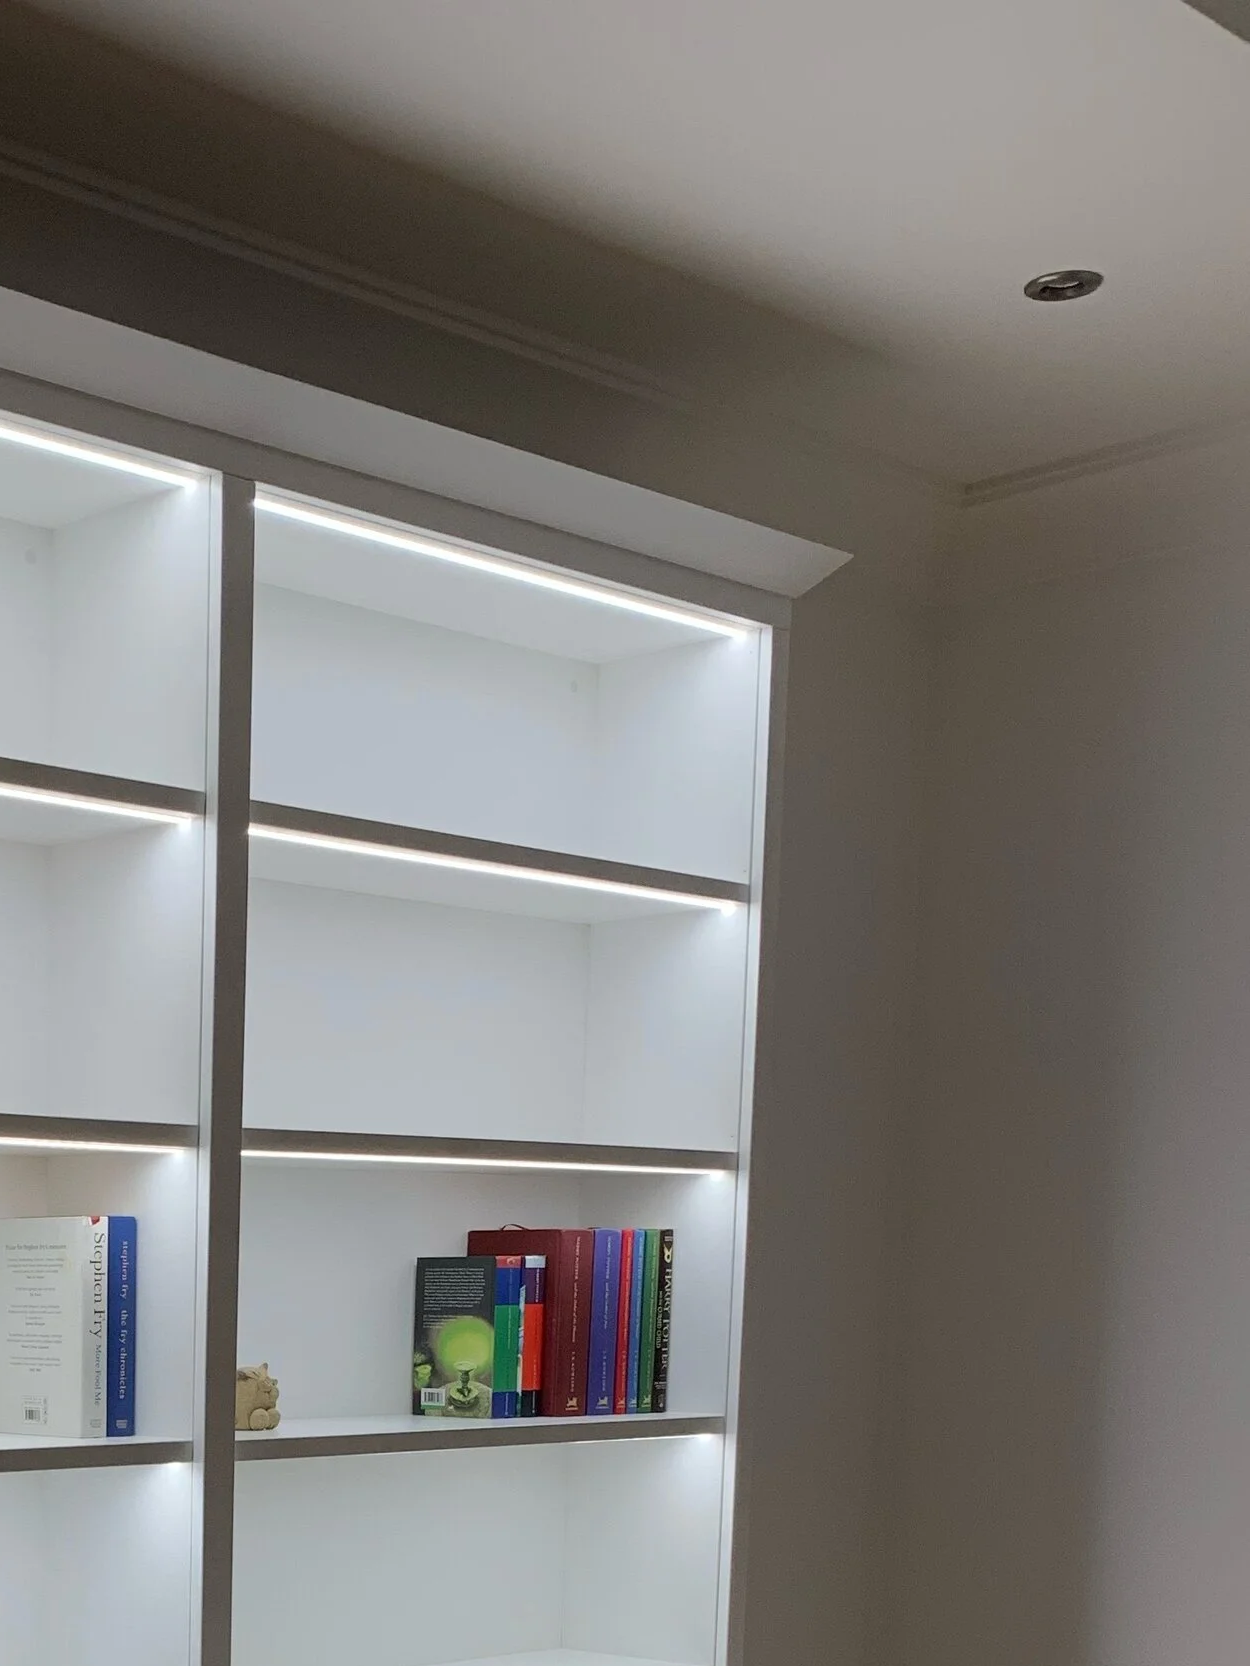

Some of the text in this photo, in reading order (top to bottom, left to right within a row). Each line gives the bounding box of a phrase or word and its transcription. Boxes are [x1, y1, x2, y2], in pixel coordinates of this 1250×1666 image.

[89, 1232, 106, 1341] Stephen Fry
[120, 1241, 128, 1300] stephen fry
[663, 1268, 673, 1313] HARRY
[119, 1329, 127, 1345] fry
[94, 1345, 102, 1406] More Fool Me
[119, 1347, 127, 1399] chronicles
